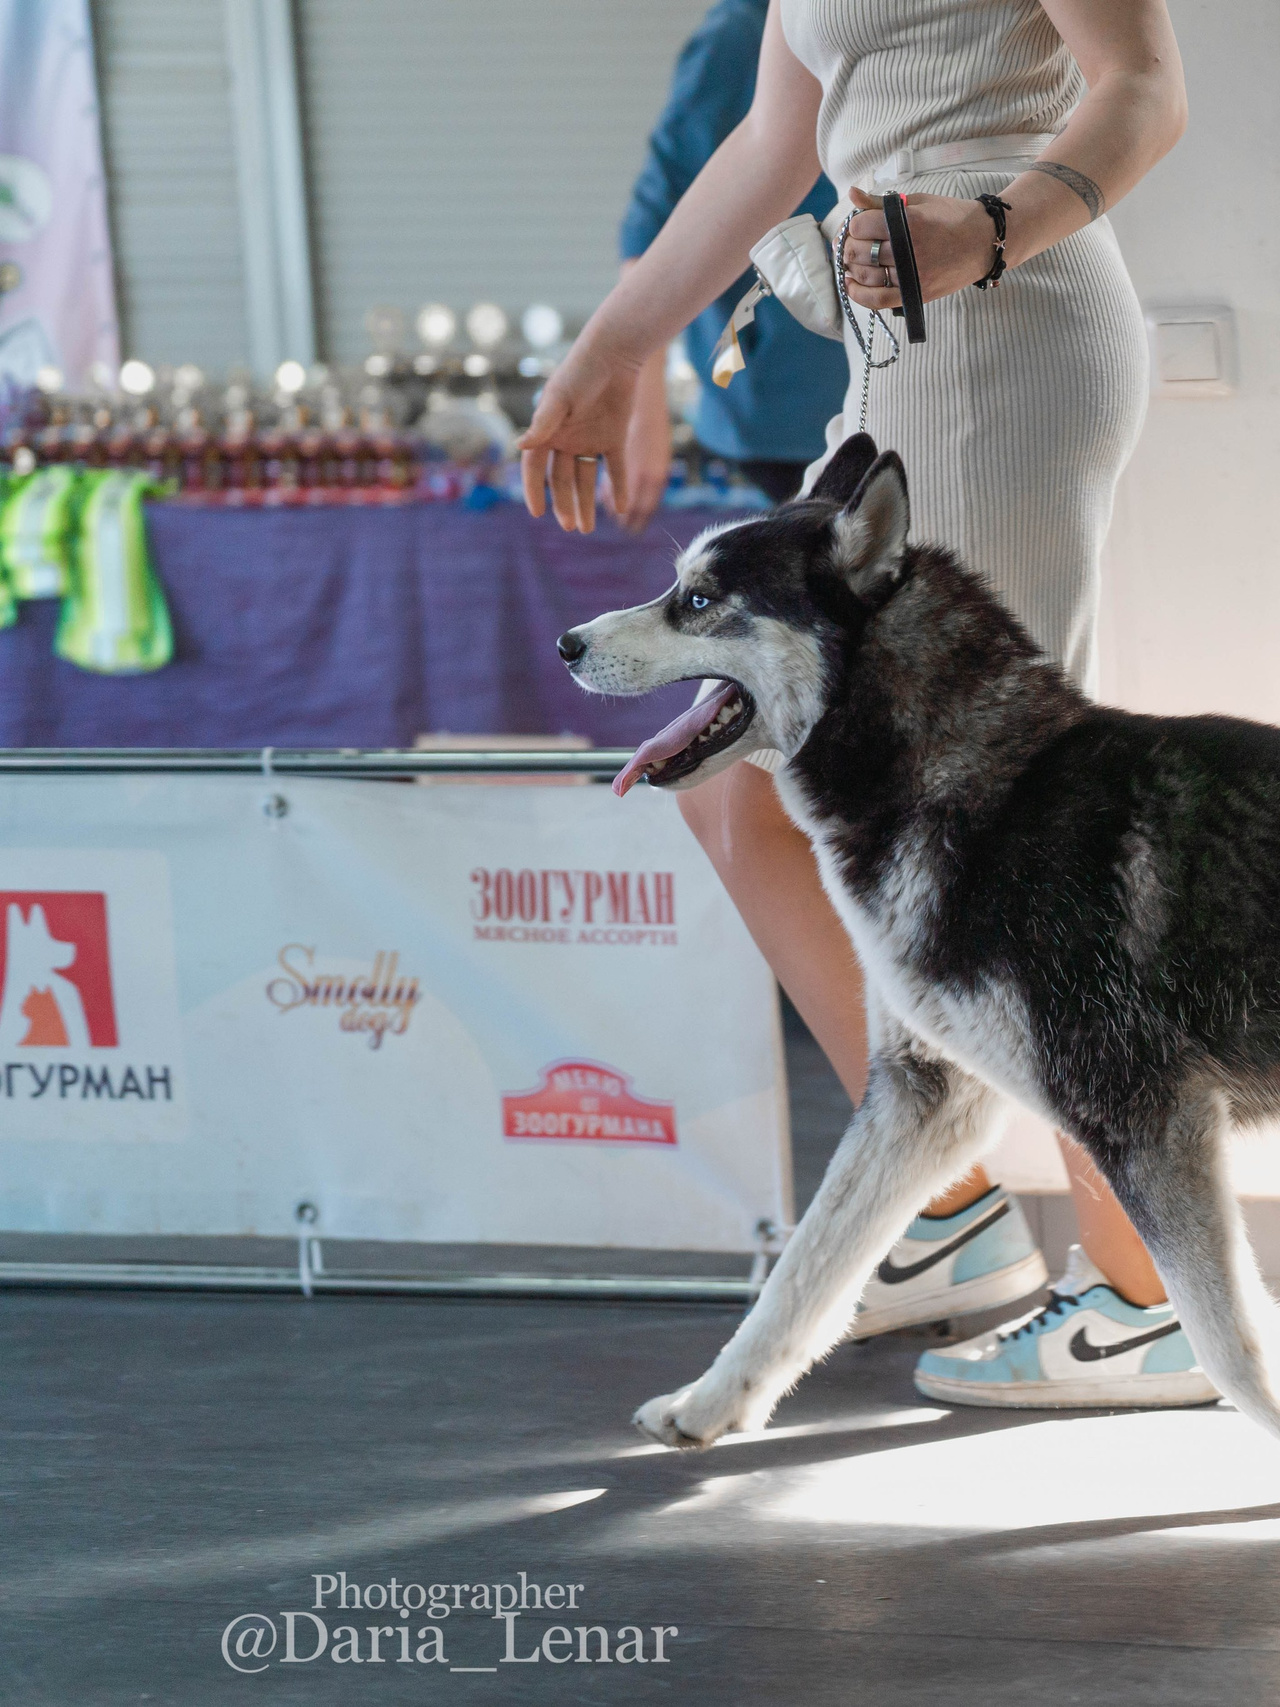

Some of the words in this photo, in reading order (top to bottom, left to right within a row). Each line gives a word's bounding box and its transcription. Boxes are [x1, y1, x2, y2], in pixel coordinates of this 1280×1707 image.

[469, 867, 675, 924] ЗООГУРМАН
[473, 925, 571, 945] МЯСНОЕ
[577, 928, 678, 946] АССОРТИ
[0, 1062, 172, 1100] ГУРМАН
[511, 1110, 666, 1138] ЗООГУРМАНА
